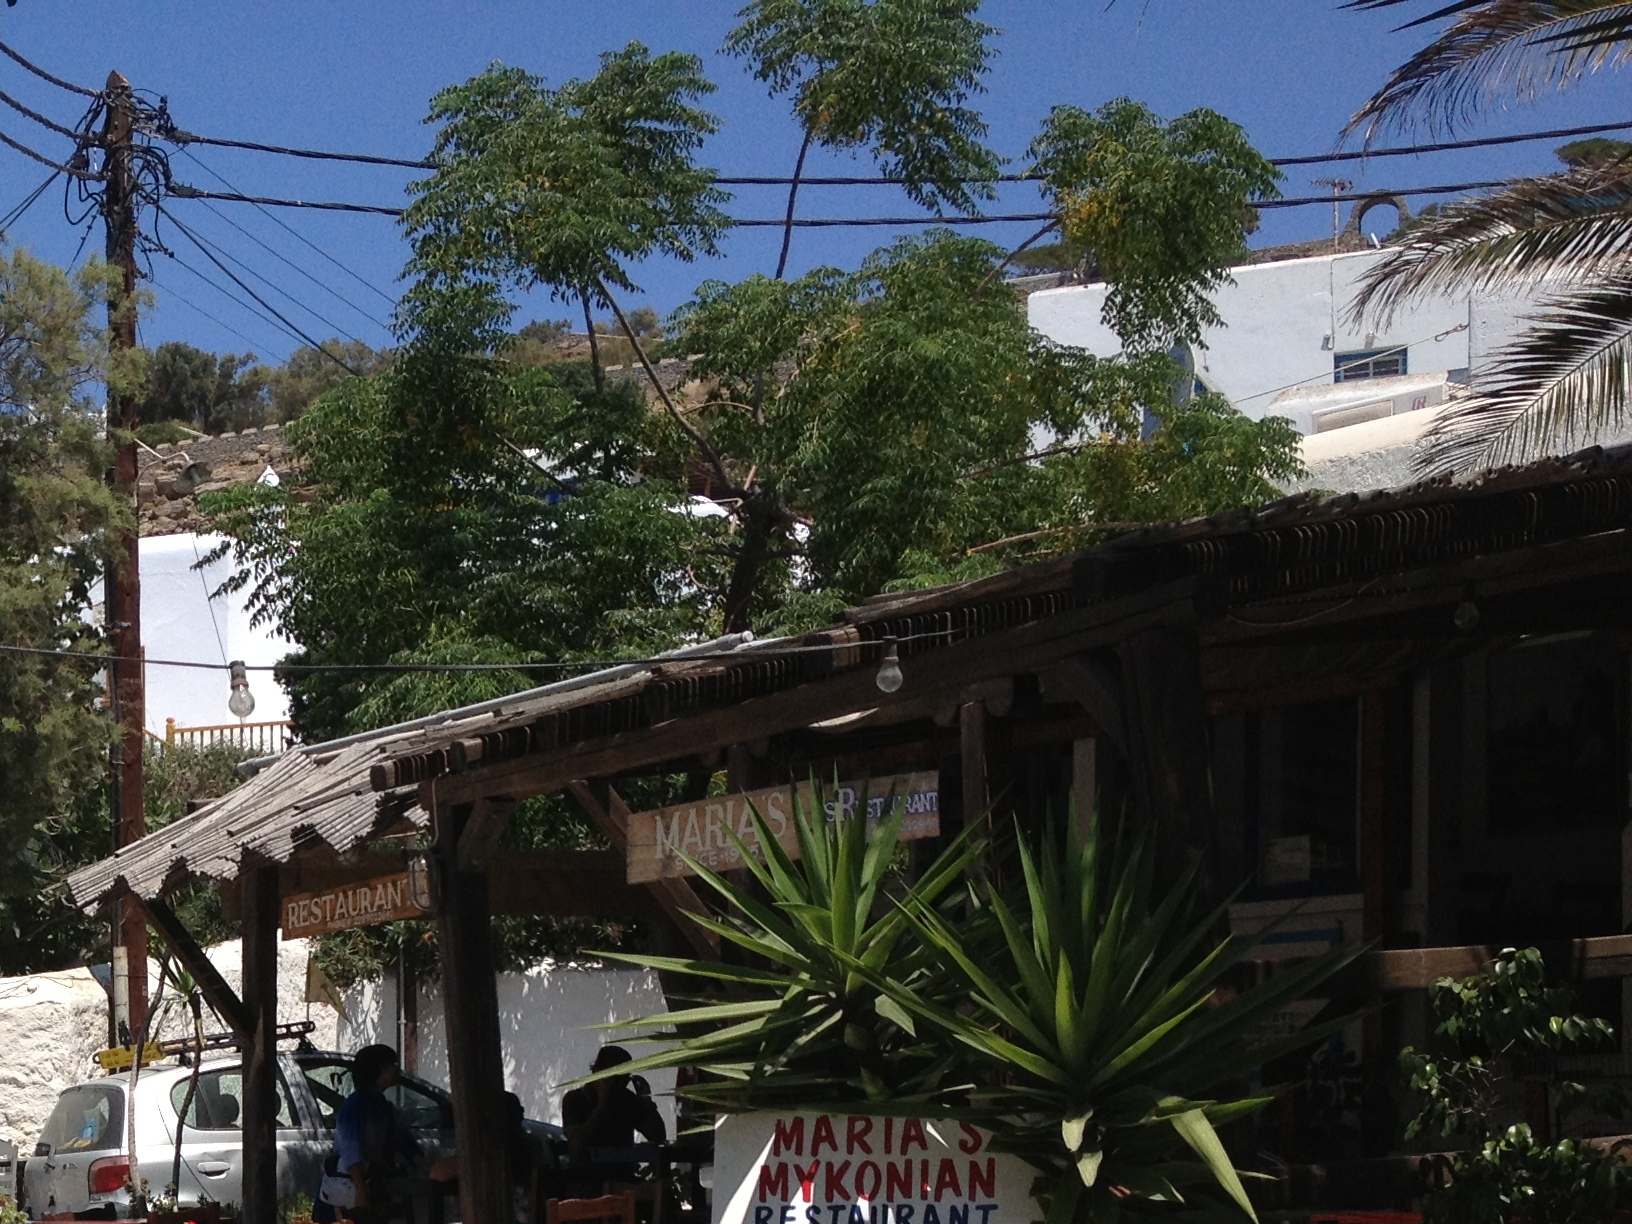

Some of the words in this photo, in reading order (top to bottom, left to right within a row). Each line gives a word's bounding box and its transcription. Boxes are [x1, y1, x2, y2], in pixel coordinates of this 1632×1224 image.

[654, 791, 787, 859] MARIA'S
[674, 850, 717, 871] SCE
[773, 1114, 983, 1158] MARIAS
[758, 1157, 996, 1203] MYKONIAN
